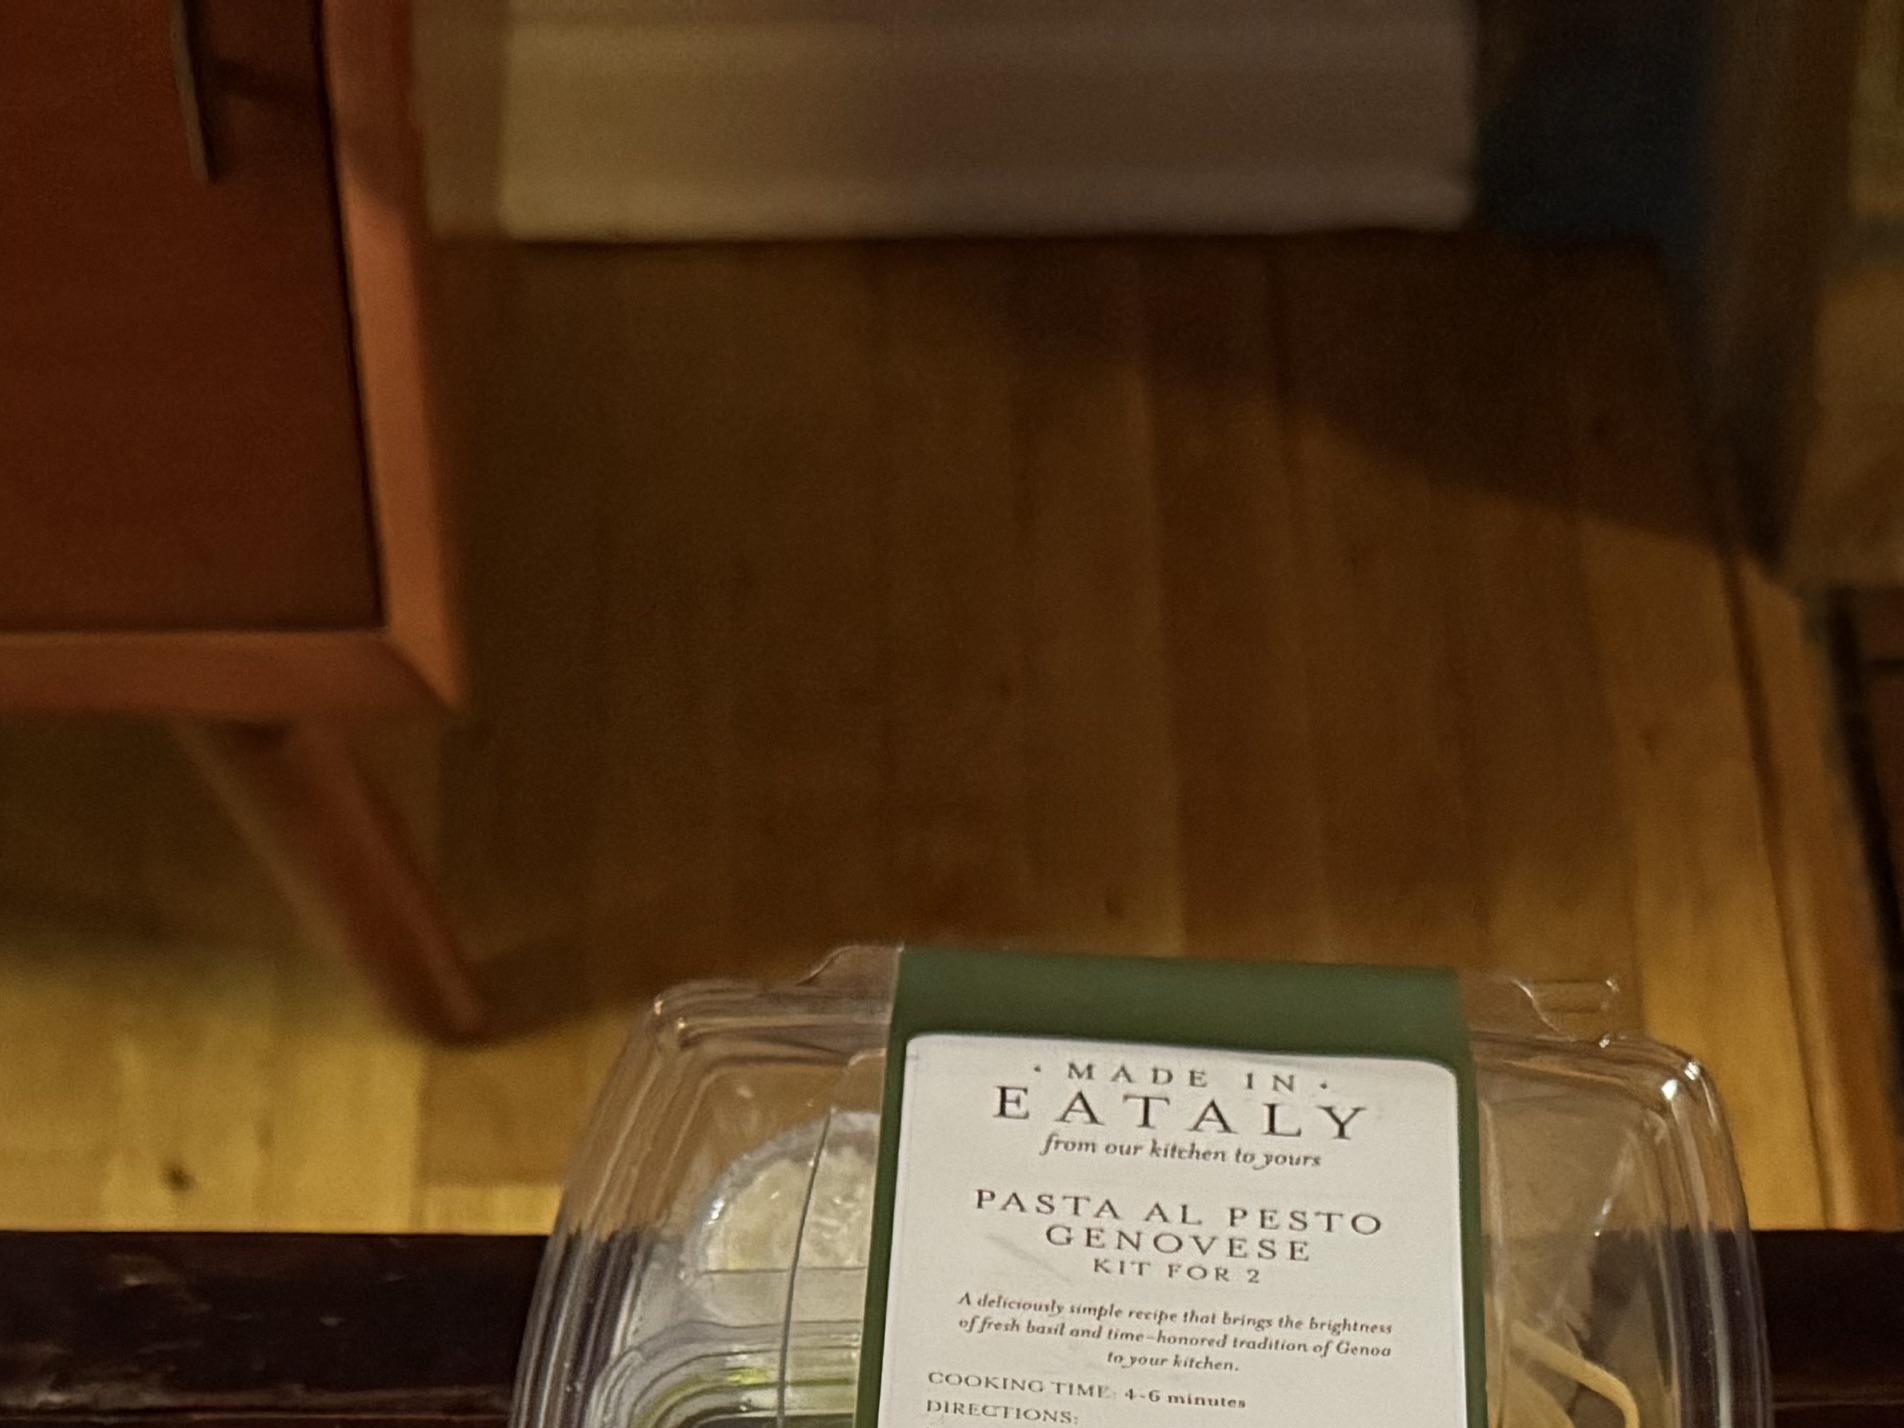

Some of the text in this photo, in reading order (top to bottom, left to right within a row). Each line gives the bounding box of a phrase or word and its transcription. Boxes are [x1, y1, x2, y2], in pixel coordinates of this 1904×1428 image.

[1067, 1061, 1295, 1094] MADE IN
[992, 1085, 1368, 1141] EATALY
[1038, 1130, 1321, 1171] from our kitchen to yours
[976, 1188, 1382, 1235] PASTA AL PESTO
[1045, 1222, 1309, 1262] GENOVESE
[1093, 1257, 1260, 1284] KIT FOR 2
[957, 1291, 1392, 1336] A deliciously simple recipe that brings the brightness
